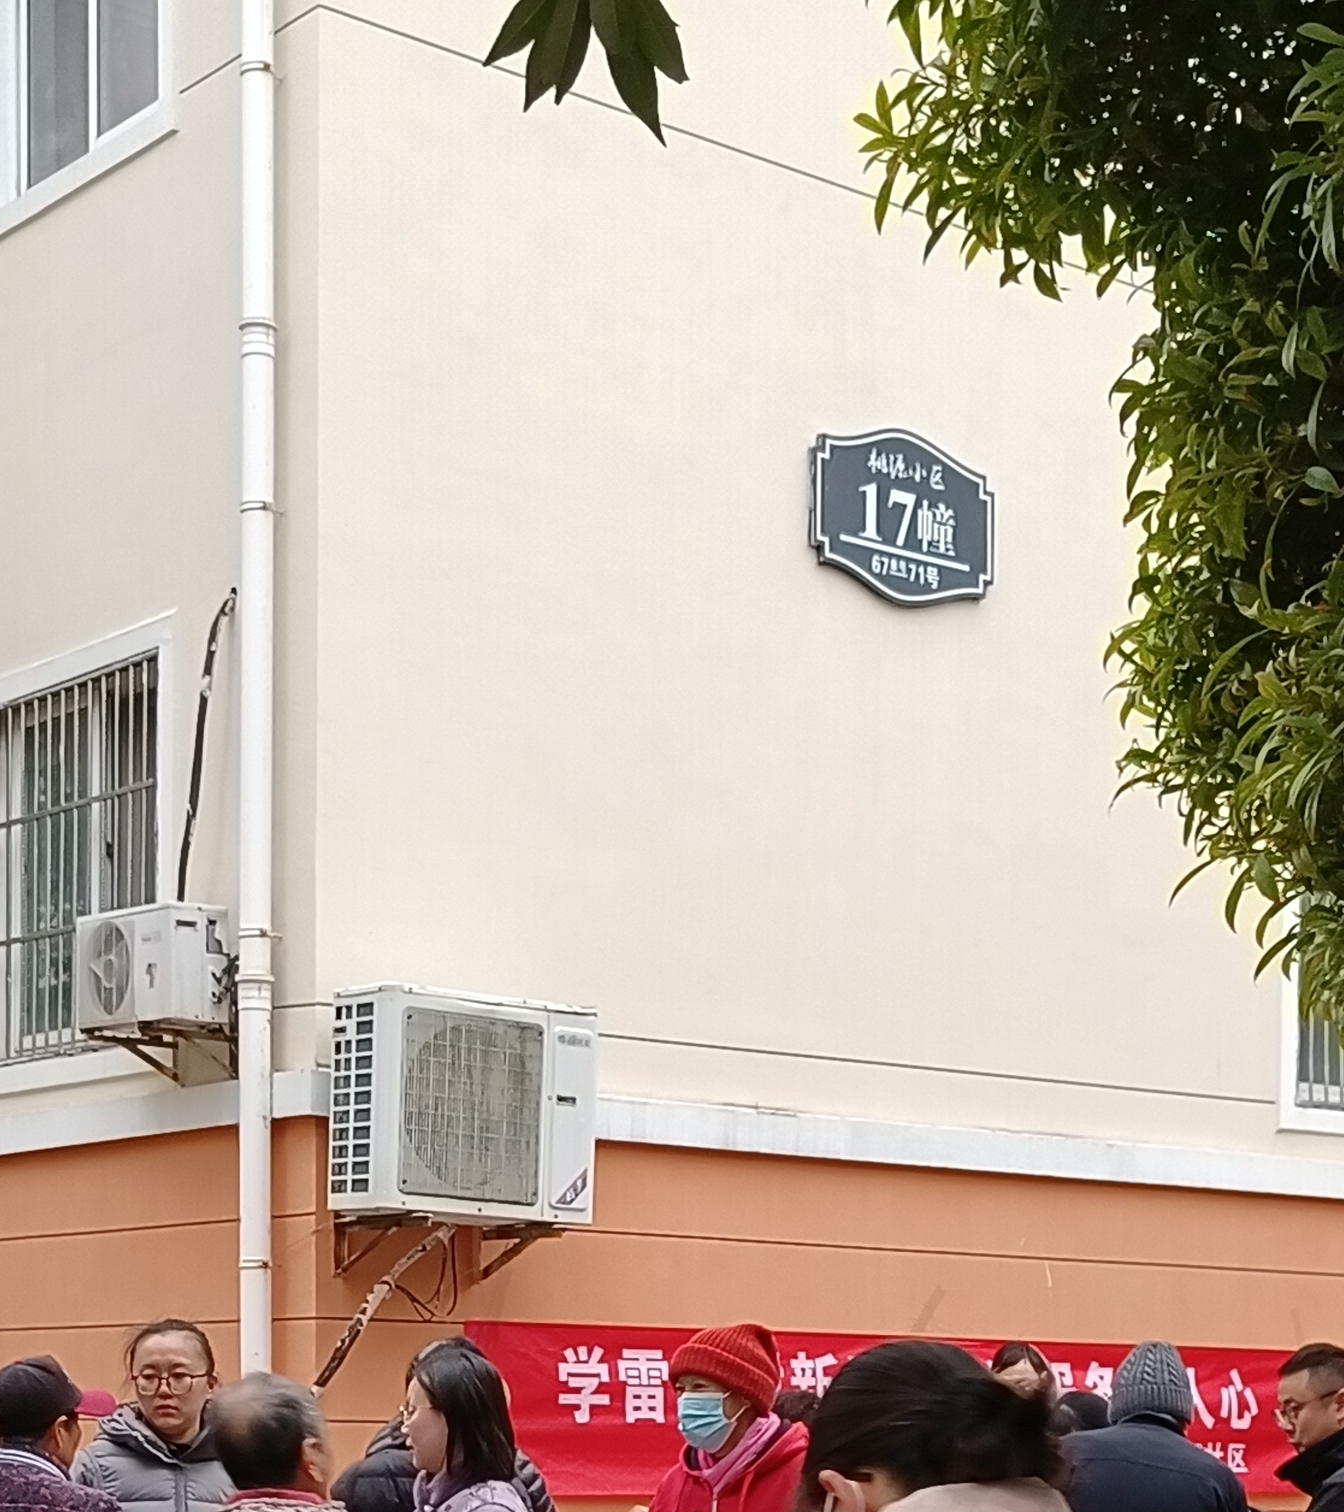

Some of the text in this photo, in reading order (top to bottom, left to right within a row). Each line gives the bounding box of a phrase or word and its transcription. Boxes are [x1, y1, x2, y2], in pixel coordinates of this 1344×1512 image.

[866, 447, 946, 491] 桃源小区
[858, 482, 956, 556] 17幢
